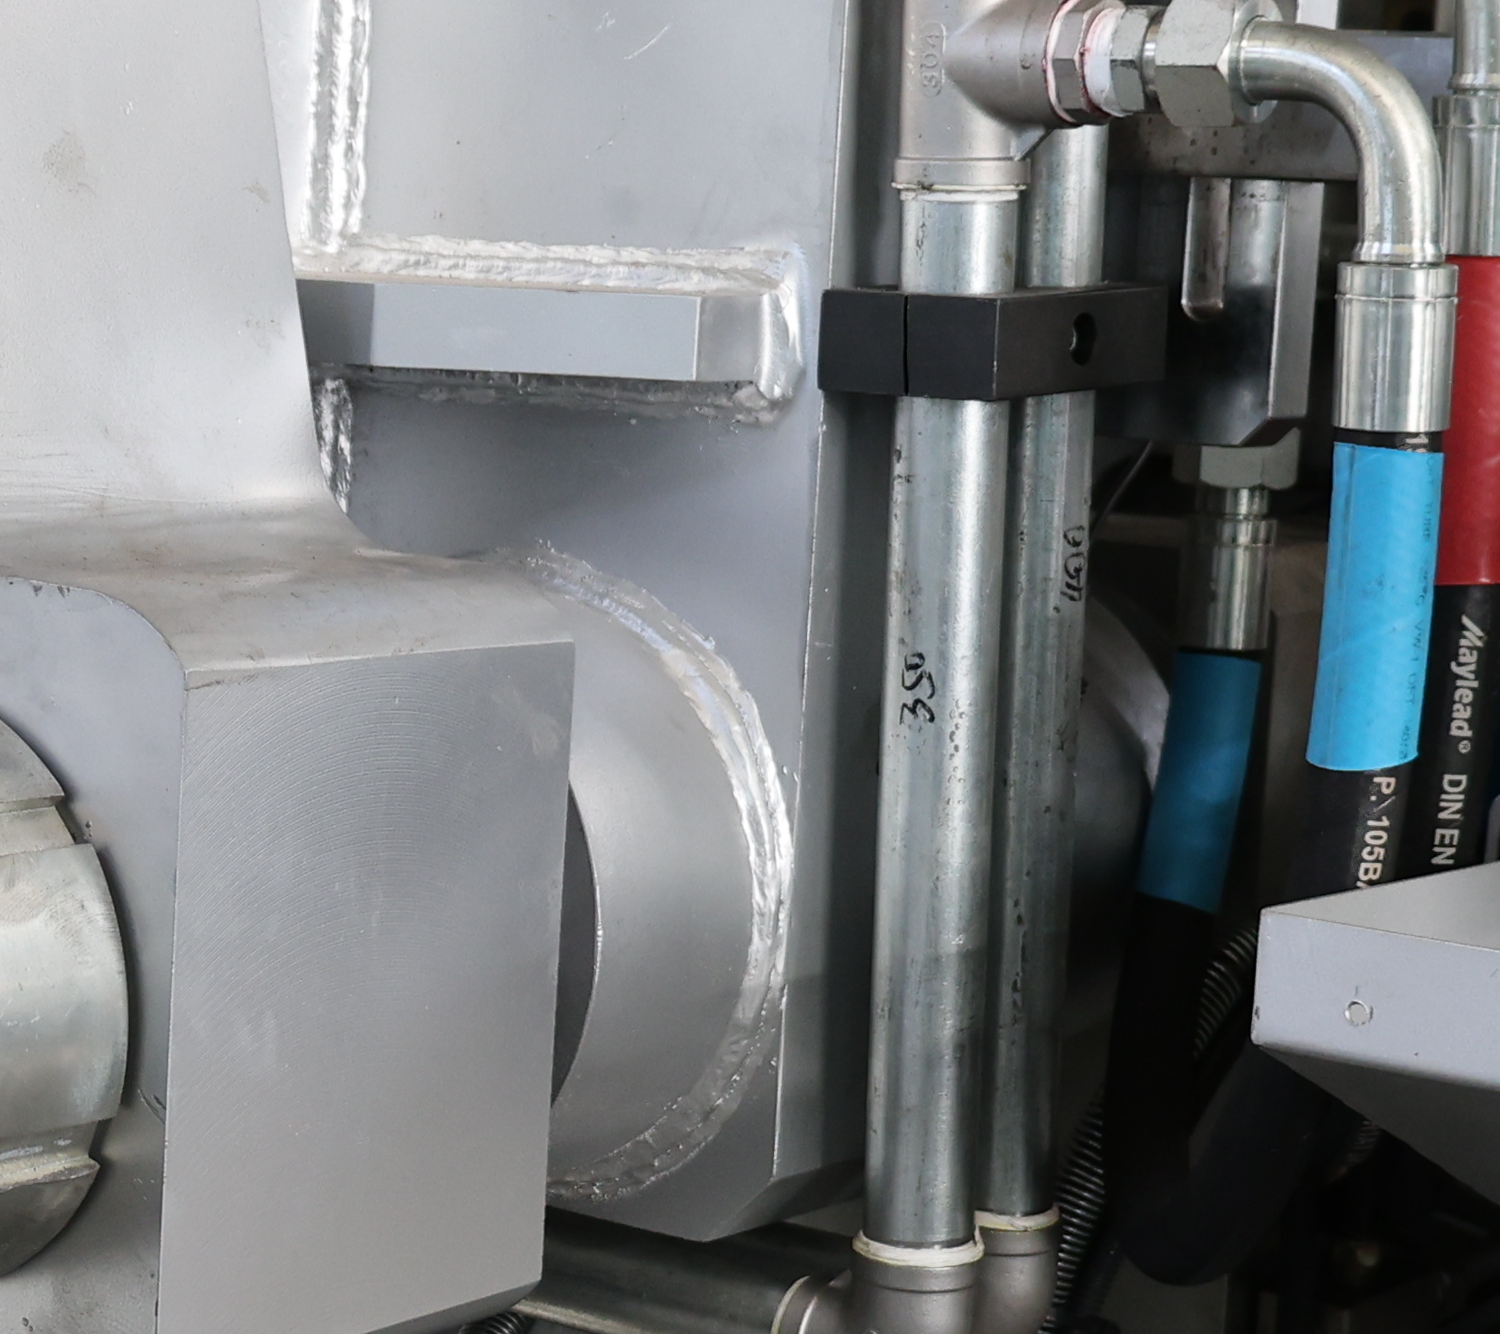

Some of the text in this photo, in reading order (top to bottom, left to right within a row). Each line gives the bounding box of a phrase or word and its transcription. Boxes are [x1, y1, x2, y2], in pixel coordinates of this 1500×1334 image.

[898, 652, 935, 725] 350
[1437, 774, 1467, 820] DIN
[1430, 828, 1459, 865] EN
